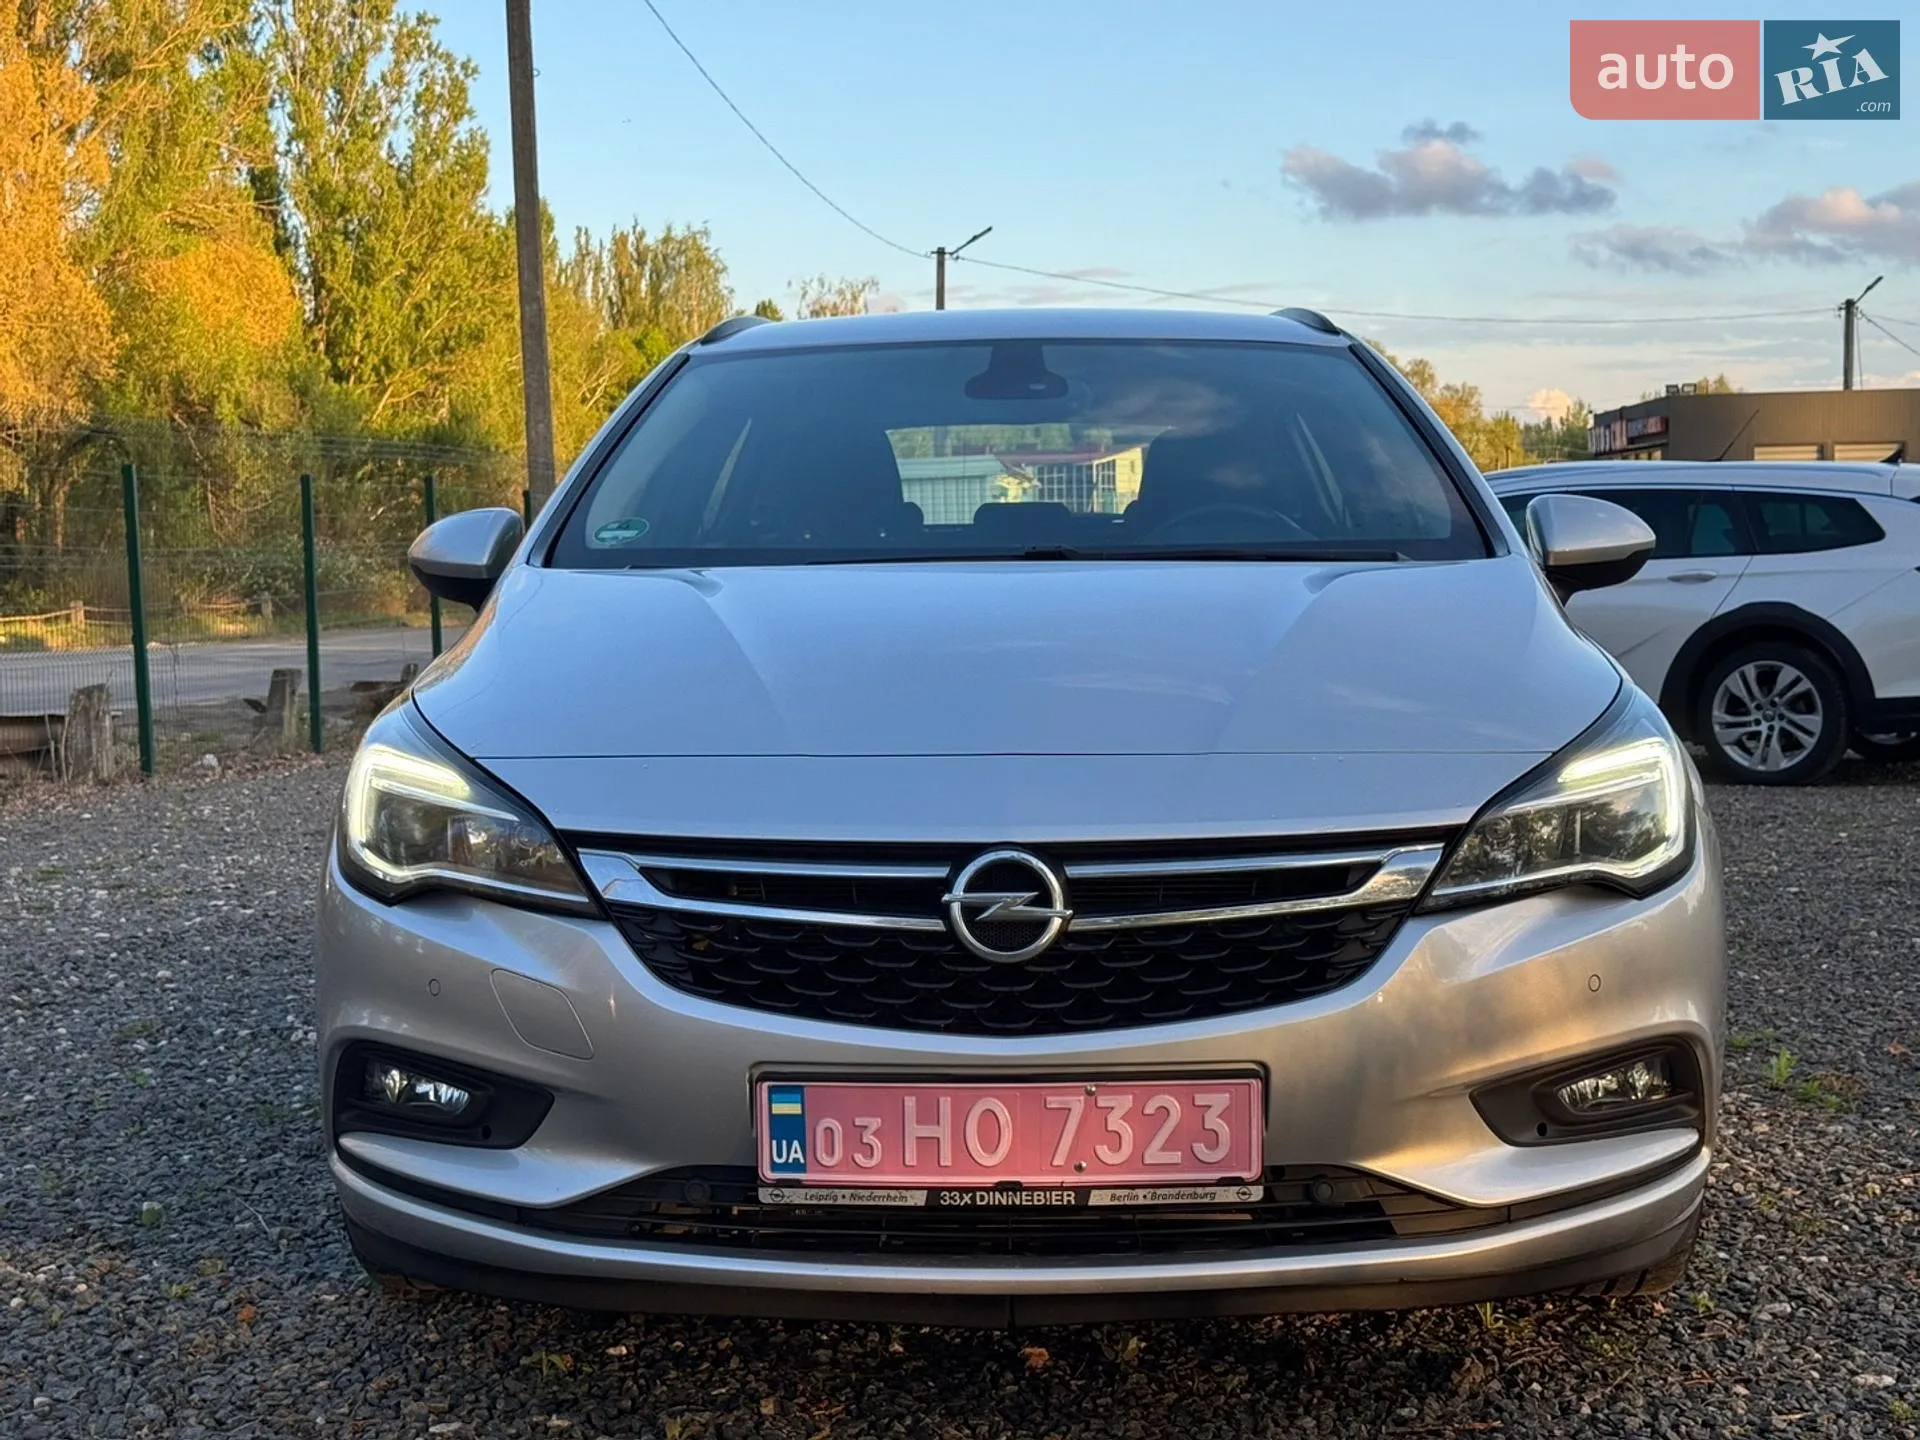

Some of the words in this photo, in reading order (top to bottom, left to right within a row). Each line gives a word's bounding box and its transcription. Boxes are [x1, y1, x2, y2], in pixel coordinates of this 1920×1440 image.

[815, 1117, 882, 1168] 03
[904, 1095, 1013, 1167] HO
[1046, 1093, 1231, 1166] 7323
[772, 1140, 805, 1164] UA
[804, 1191, 839, 1203] Leipzig
[976, 1191, 1076, 1206] DINNEBIER
[1110, 1192, 1139, 1202] Berlin
[1150, 1189, 1216, 1201] Brandenburg
